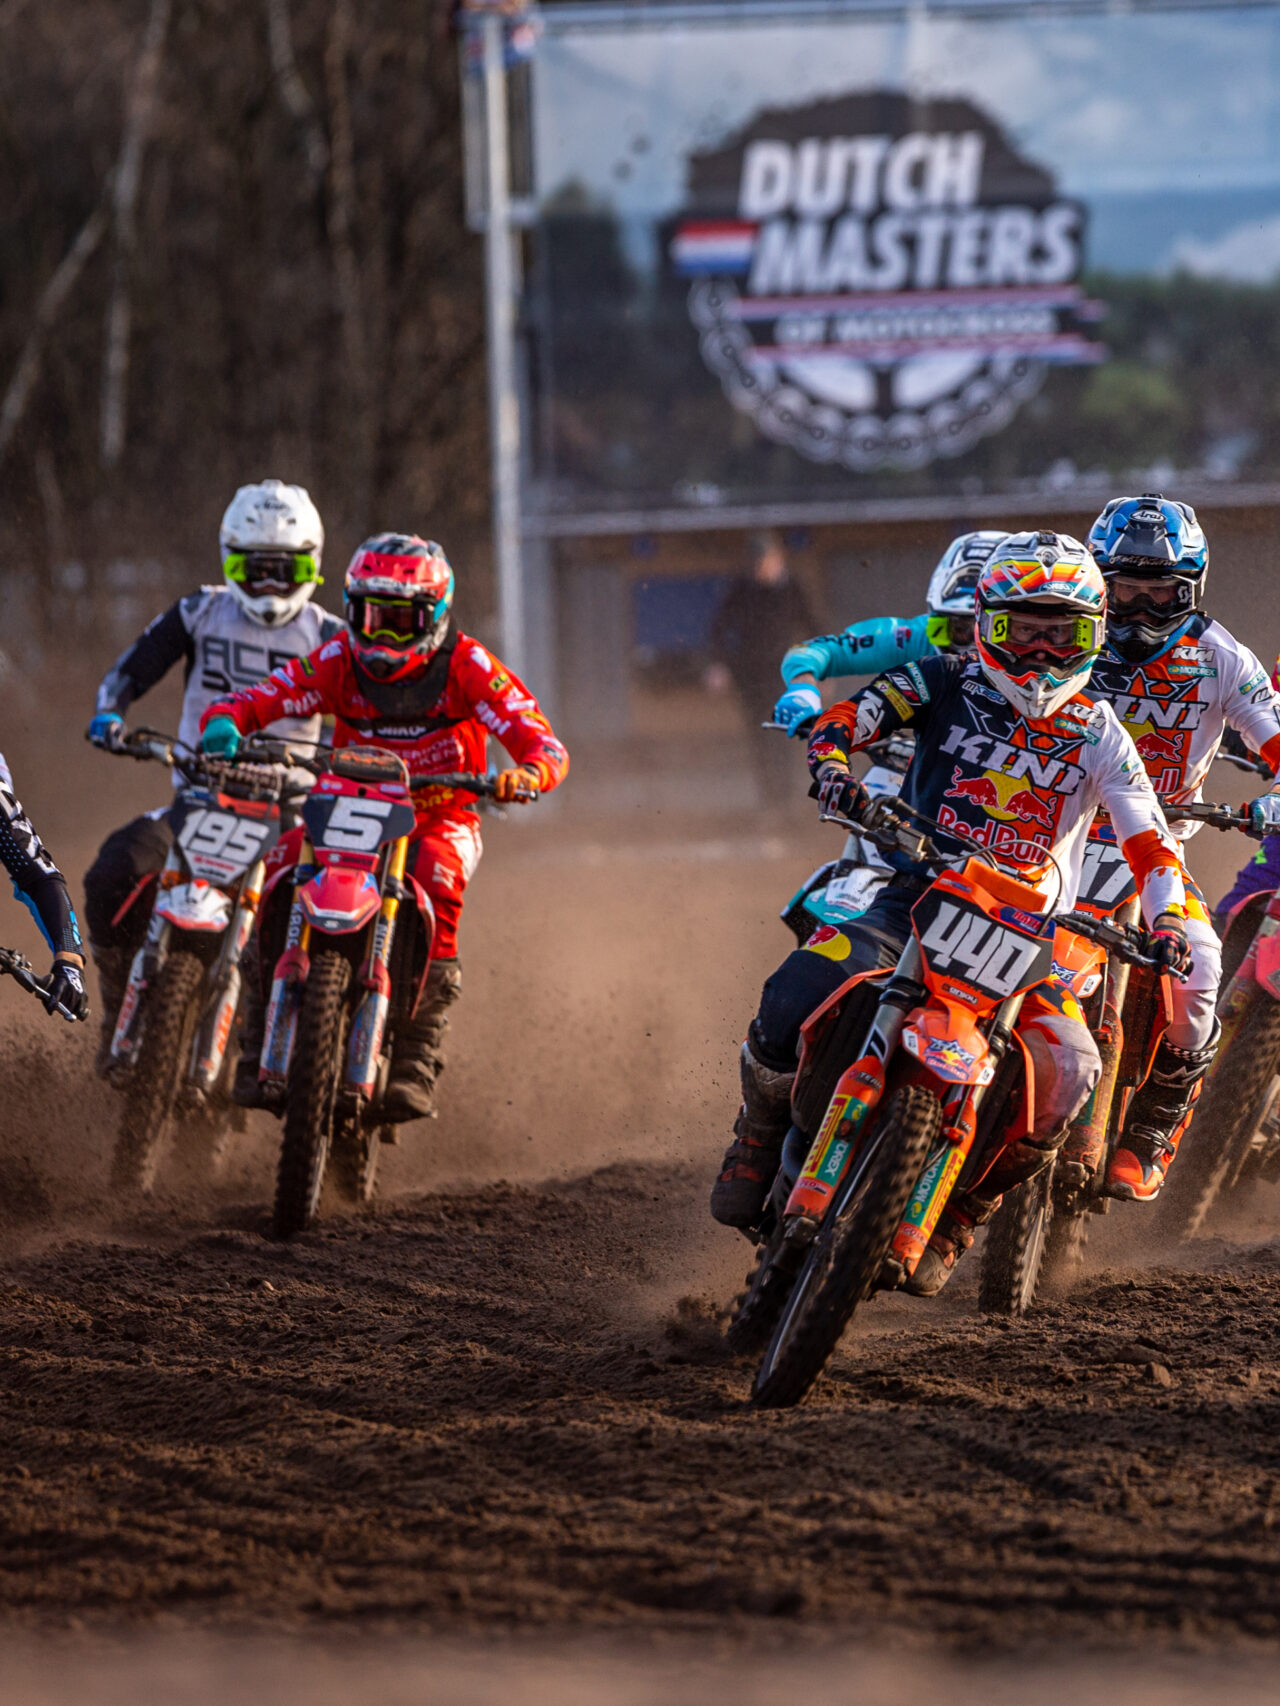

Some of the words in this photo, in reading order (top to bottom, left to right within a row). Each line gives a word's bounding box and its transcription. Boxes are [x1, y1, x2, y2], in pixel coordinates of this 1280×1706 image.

[740, 132, 984, 217] DUTCH
[749, 202, 1081, 295] MASTERS
[1171, 645, 1215, 662] KTM
[1100, 692, 1209, 731] INI
[939, 724, 1087, 795] KINI
[177, 808, 270, 864] 195
[322, 795, 393, 851] 5
[936, 803, 996, 849] Red
[993, 822, 1052, 865] Bull
[919, 900, 1042, 998] 440
